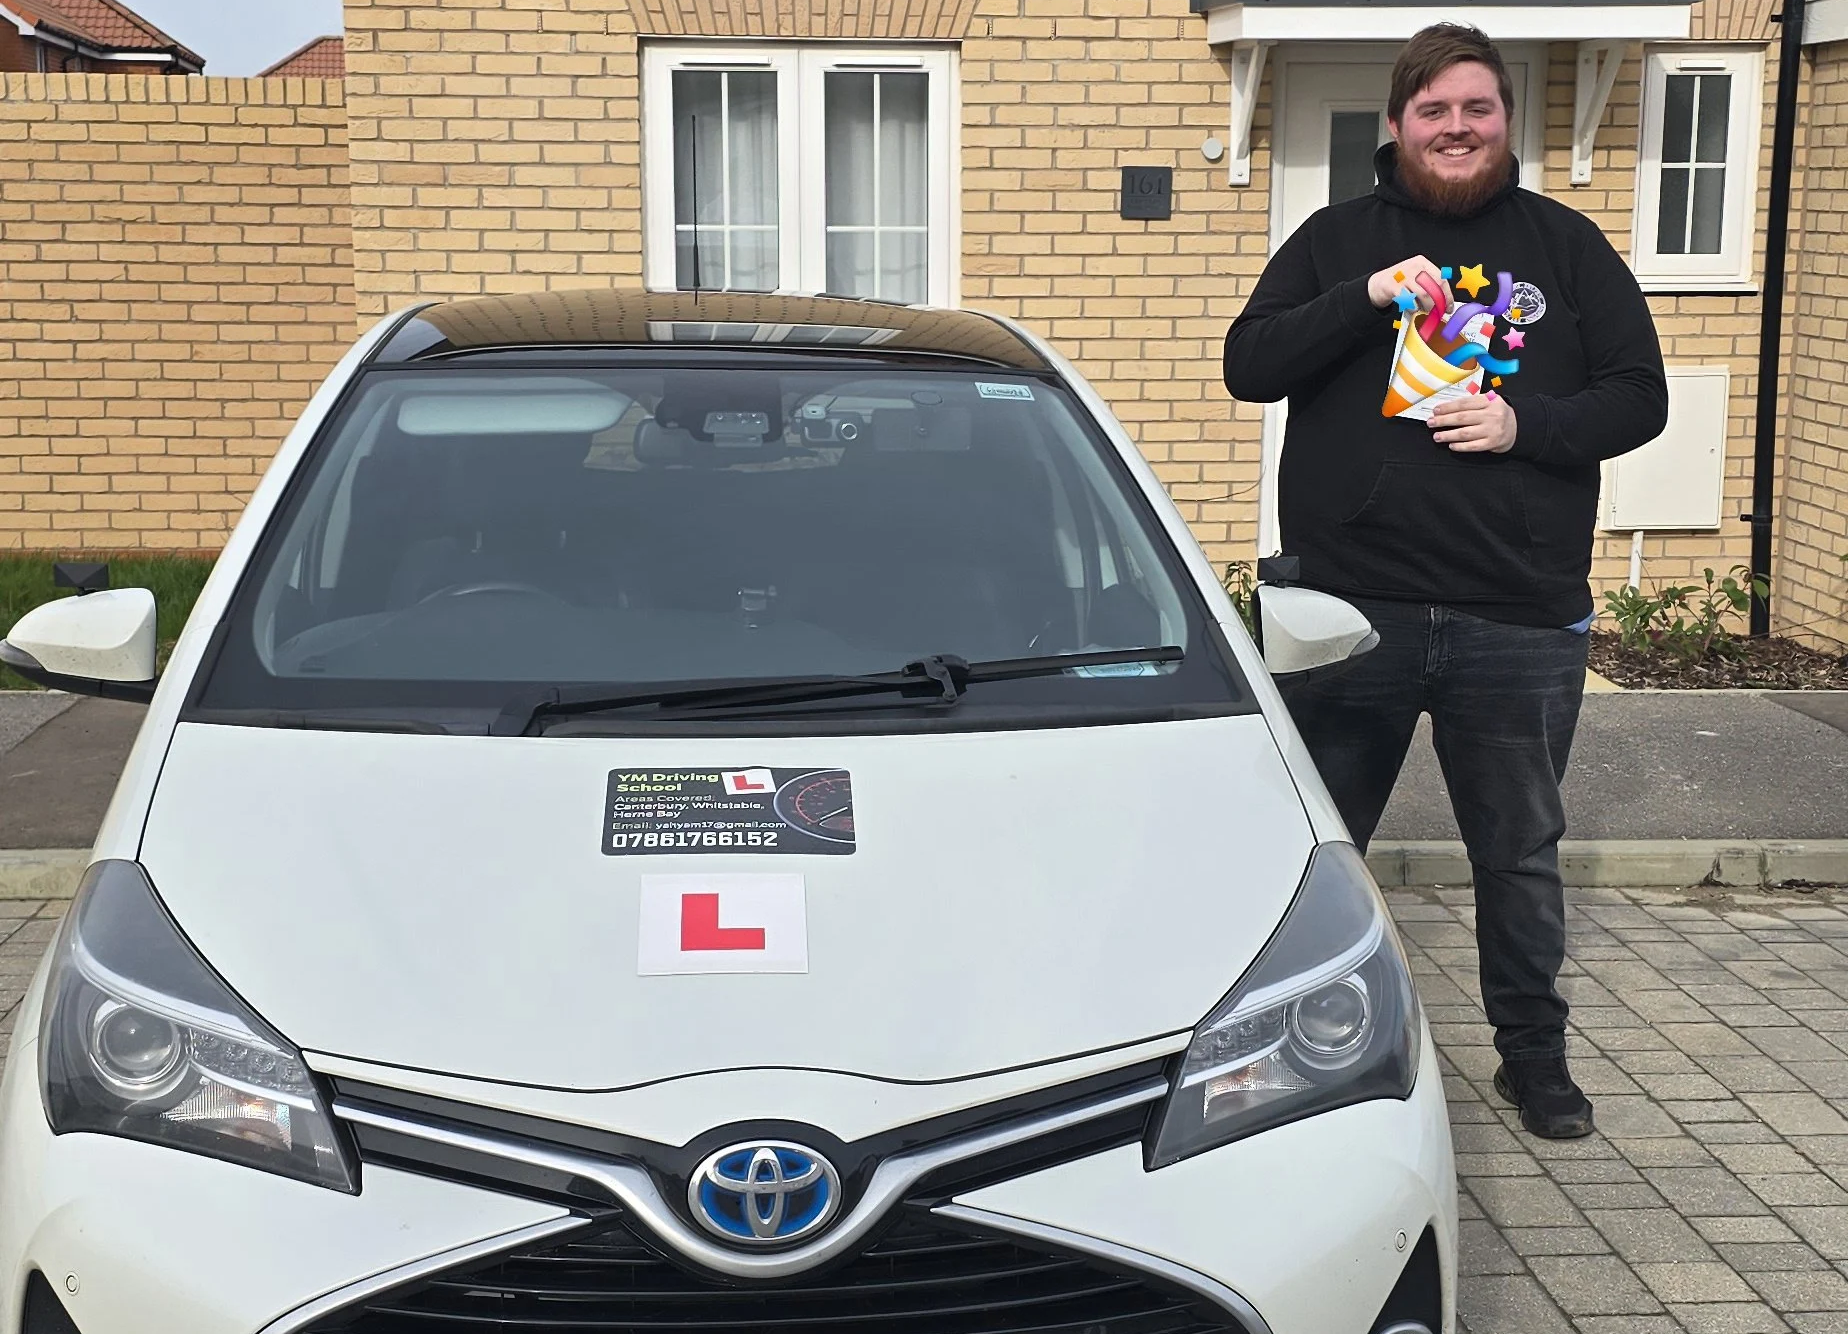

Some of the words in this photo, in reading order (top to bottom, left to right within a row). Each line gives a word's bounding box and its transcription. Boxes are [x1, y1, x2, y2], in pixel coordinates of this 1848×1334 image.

[1128, 174, 1163, 195] 161
[618, 773, 648, 782] YM
[652, 773, 719, 783] Driving
[732, 775, 765, 791] L
[616, 783, 682, 792] School
[613, 810, 653, 819] Herne
[656, 810, 681, 819] Bay
[612, 831, 778, 848] 07861766152
[680, 893, 766, 952] L
